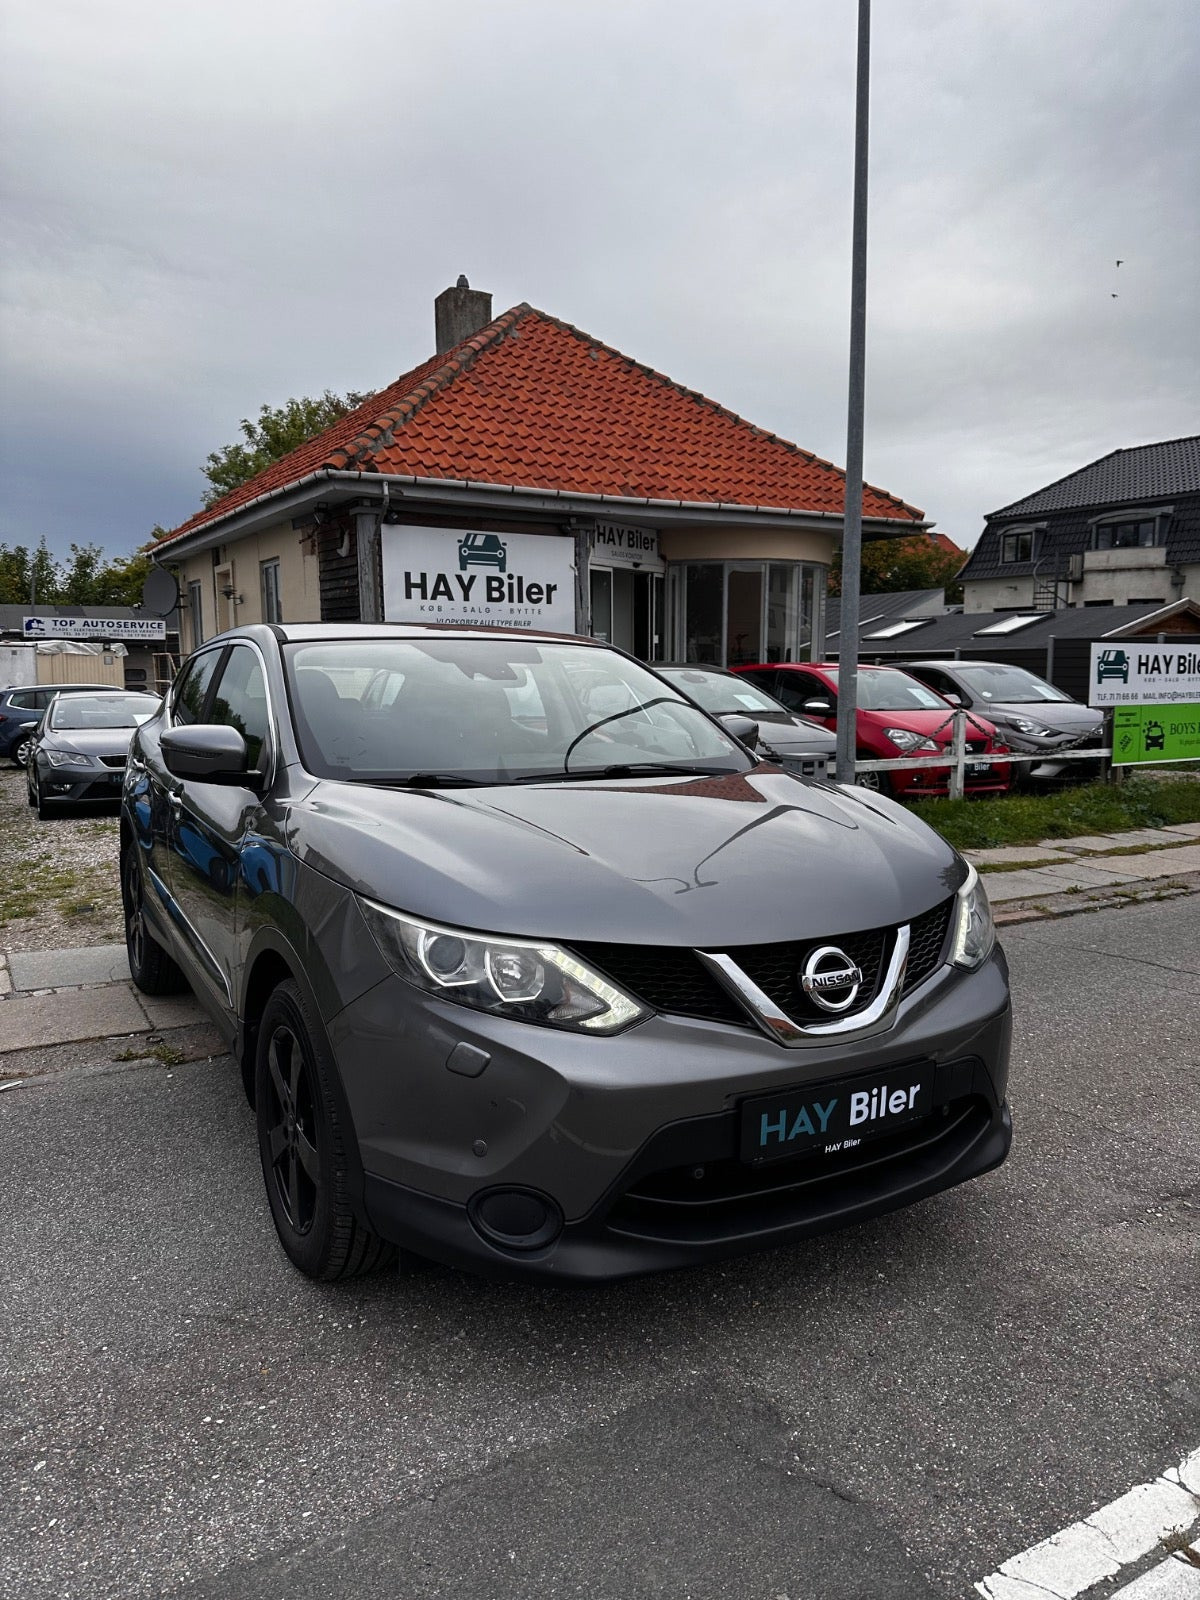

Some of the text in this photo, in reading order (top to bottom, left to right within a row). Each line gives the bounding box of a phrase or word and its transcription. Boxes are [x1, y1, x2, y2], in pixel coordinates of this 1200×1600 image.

[597, 525, 655, 551] HAY Biler
[404, 571, 557, 605] HAY Biler
[462, 606, 491, 614] SALG
[82, 620, 163, 629] AUTOSERVICE
[1137, 654, 1174, 675] HAY
[1170, 723, 1196, 735] BOYS
[974, 763, 990, 771] Biler
[812, 970, 860, 987] NISSAN
[760, 1083, 921, 1146] HAY Biler
[824, 1138, 861, 1153] HAY Biler
